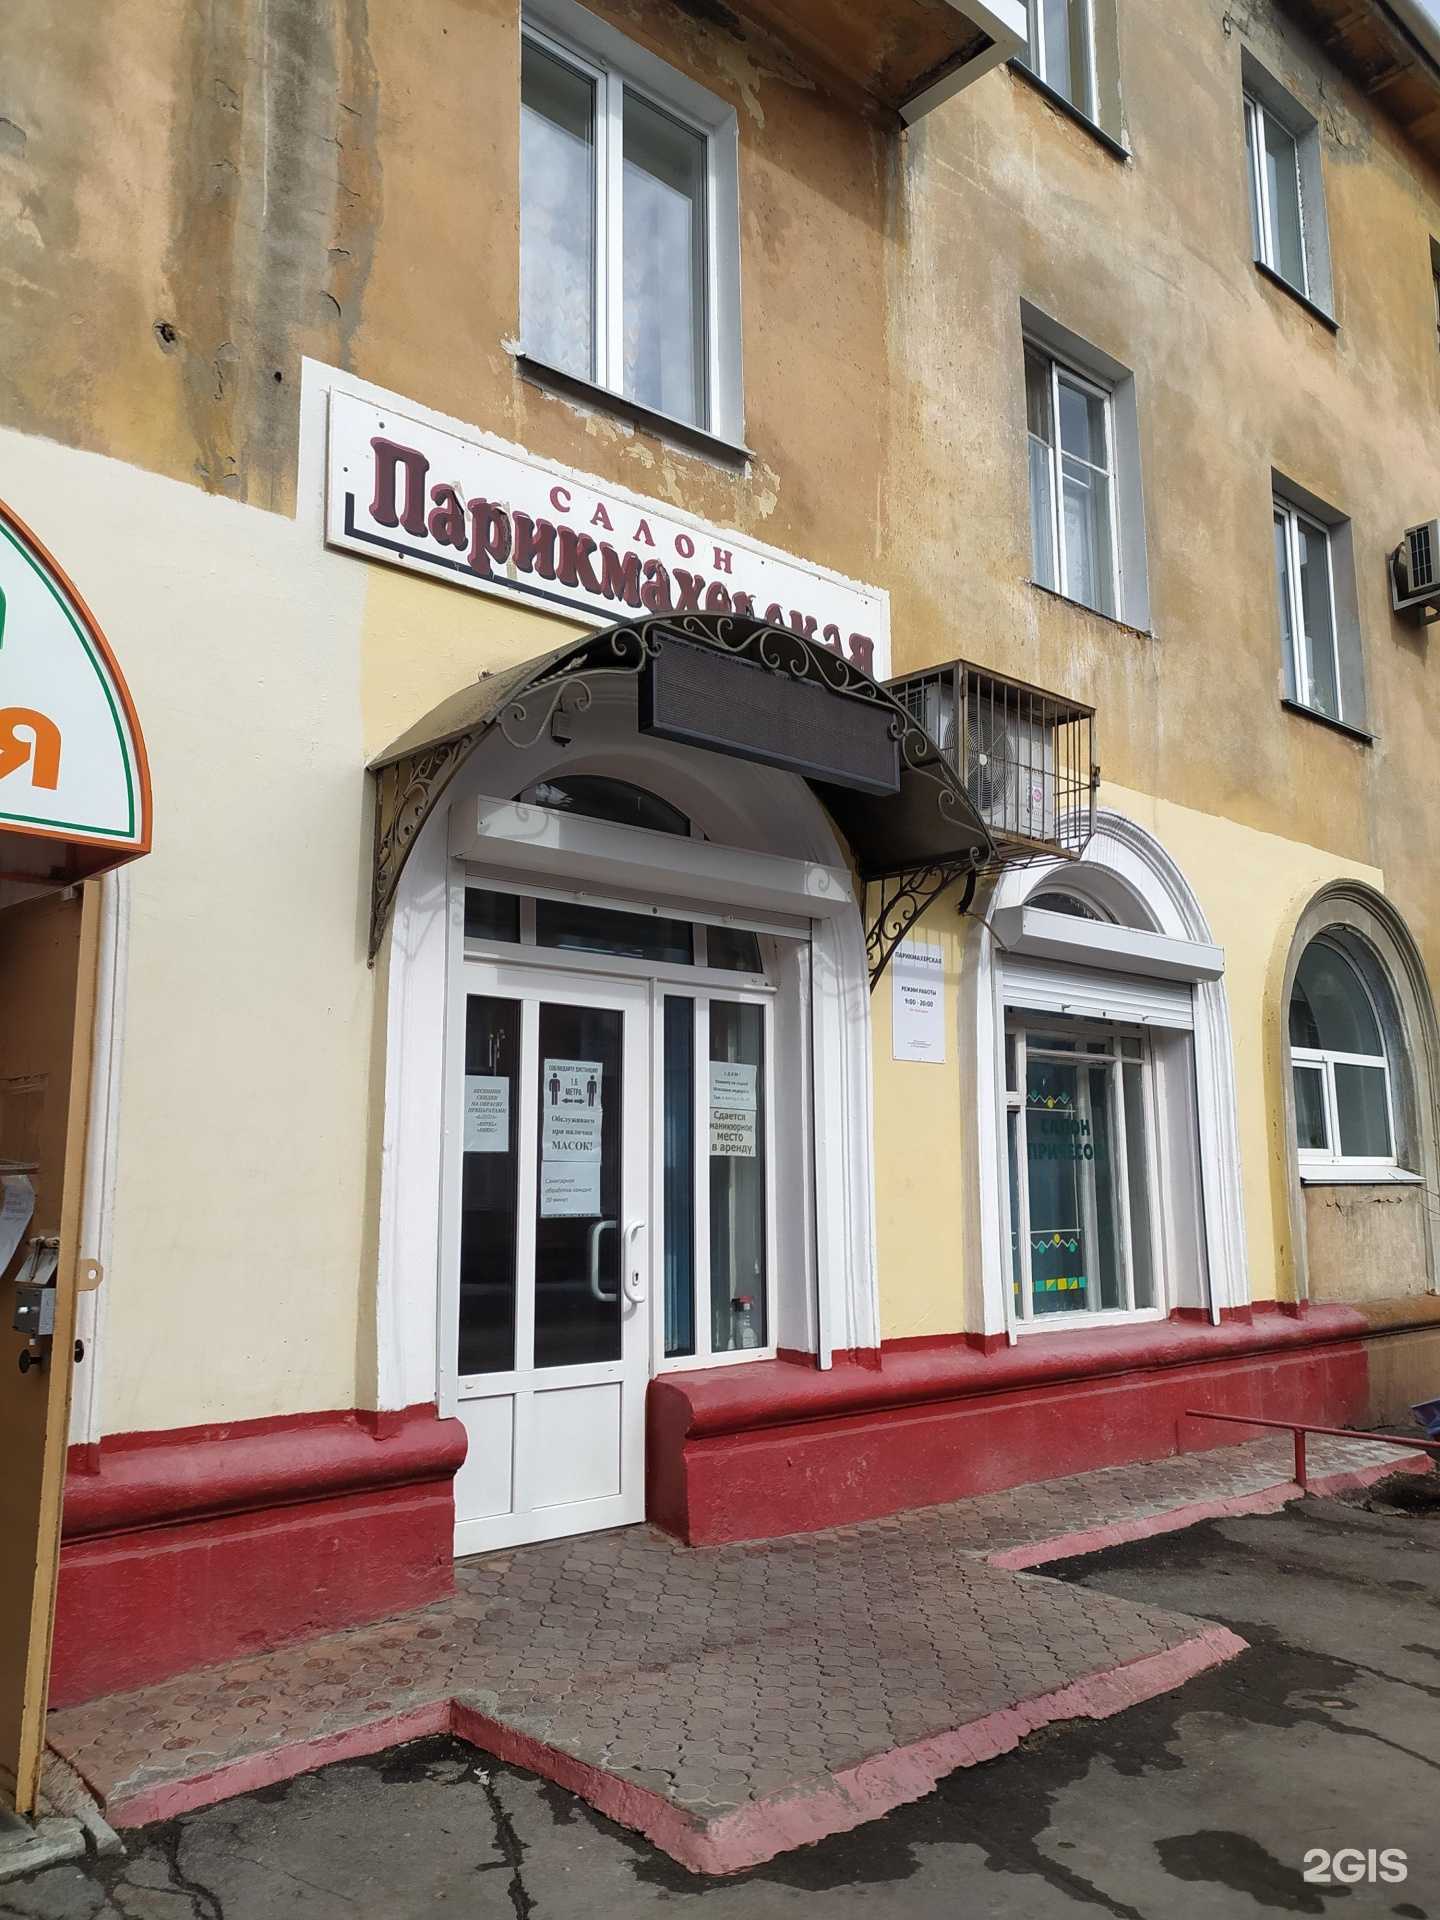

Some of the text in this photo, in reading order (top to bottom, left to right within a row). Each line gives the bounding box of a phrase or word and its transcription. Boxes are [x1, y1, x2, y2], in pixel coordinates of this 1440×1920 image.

[549, 485, 733, 575] САЛОН
[895, 951, 942, 964] ПАРИКМАХЕРСКАЯ
[713, 1111, 746, 1121] Сдается
[717, 1132, 744, 1142] место
[551, 1140, 593, 1151] МАСОК!
[719, 1144, 753, 1155] аренду
